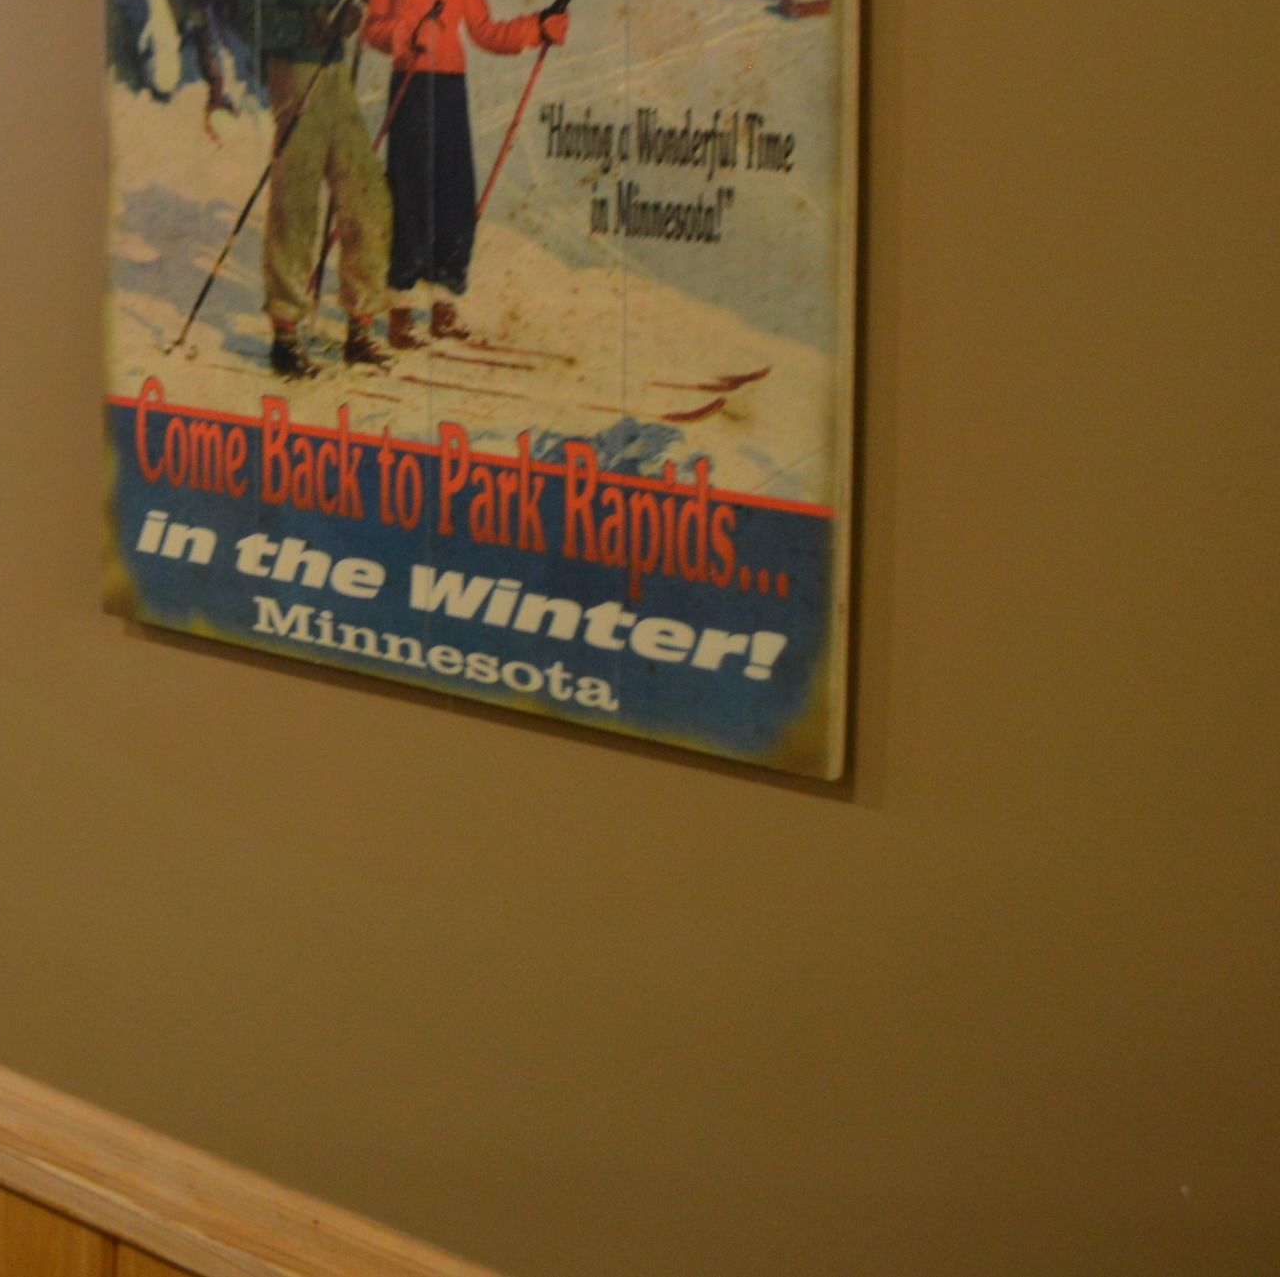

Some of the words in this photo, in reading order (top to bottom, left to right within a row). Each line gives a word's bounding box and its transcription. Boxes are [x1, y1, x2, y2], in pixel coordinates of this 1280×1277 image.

[637, 107, 739, 181] Wonderful
[745, 112, 795, 174] Time
[591, 181, 610, 235] in
[135, 376, 248, 496] Come
[259, 396, 364, 520] Back
[378, 427, 423, 530] to
[438, 421, 546, 553] Park
[562, 441, 791, 598] Rapids...
[136, 510, 216, 565] in
[234, 533, 386, 600] the
[408, 562, 787, 680] Winter!
[251, 595, 620, 712] Minnesota
